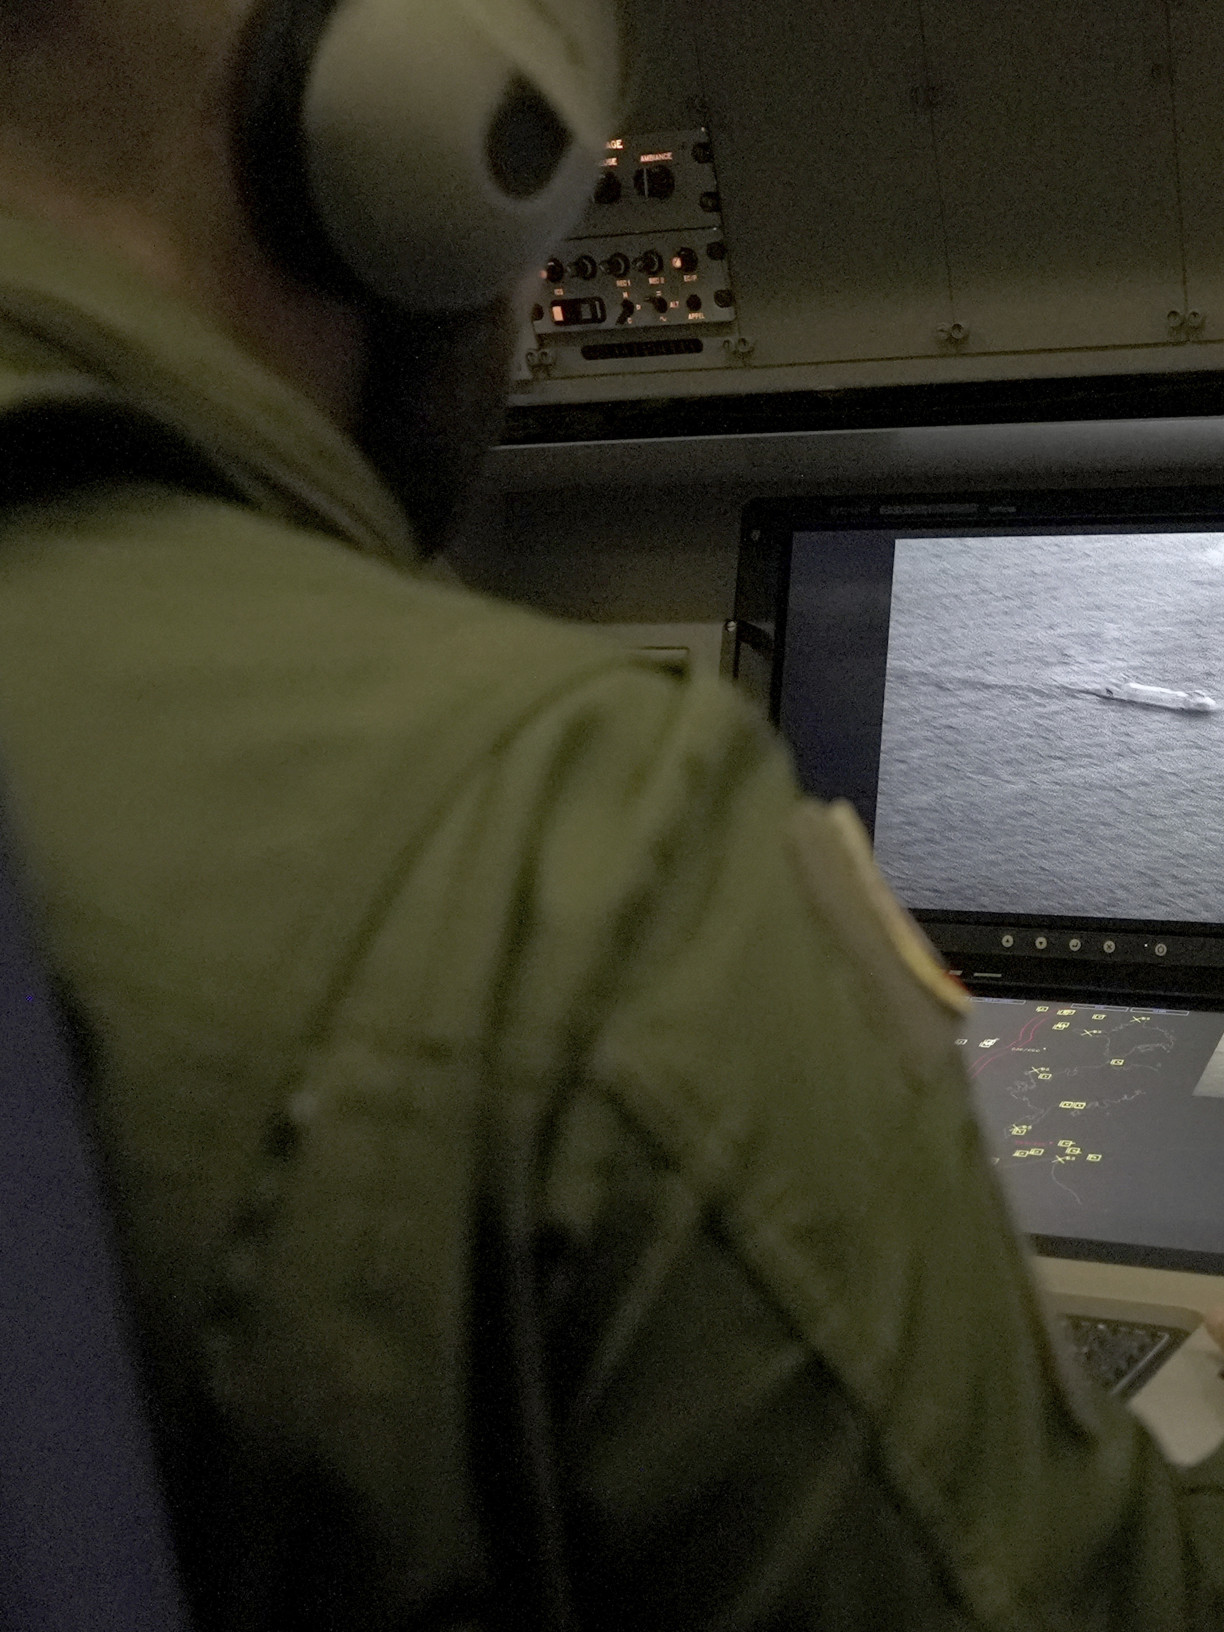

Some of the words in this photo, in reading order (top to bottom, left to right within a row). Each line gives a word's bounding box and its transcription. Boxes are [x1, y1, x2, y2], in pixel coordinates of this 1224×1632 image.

[605, 139, 624, 149] AGE
[640, 152, 673, 162] AMBIANCE
[688, 312, 705, 320] APPEL
